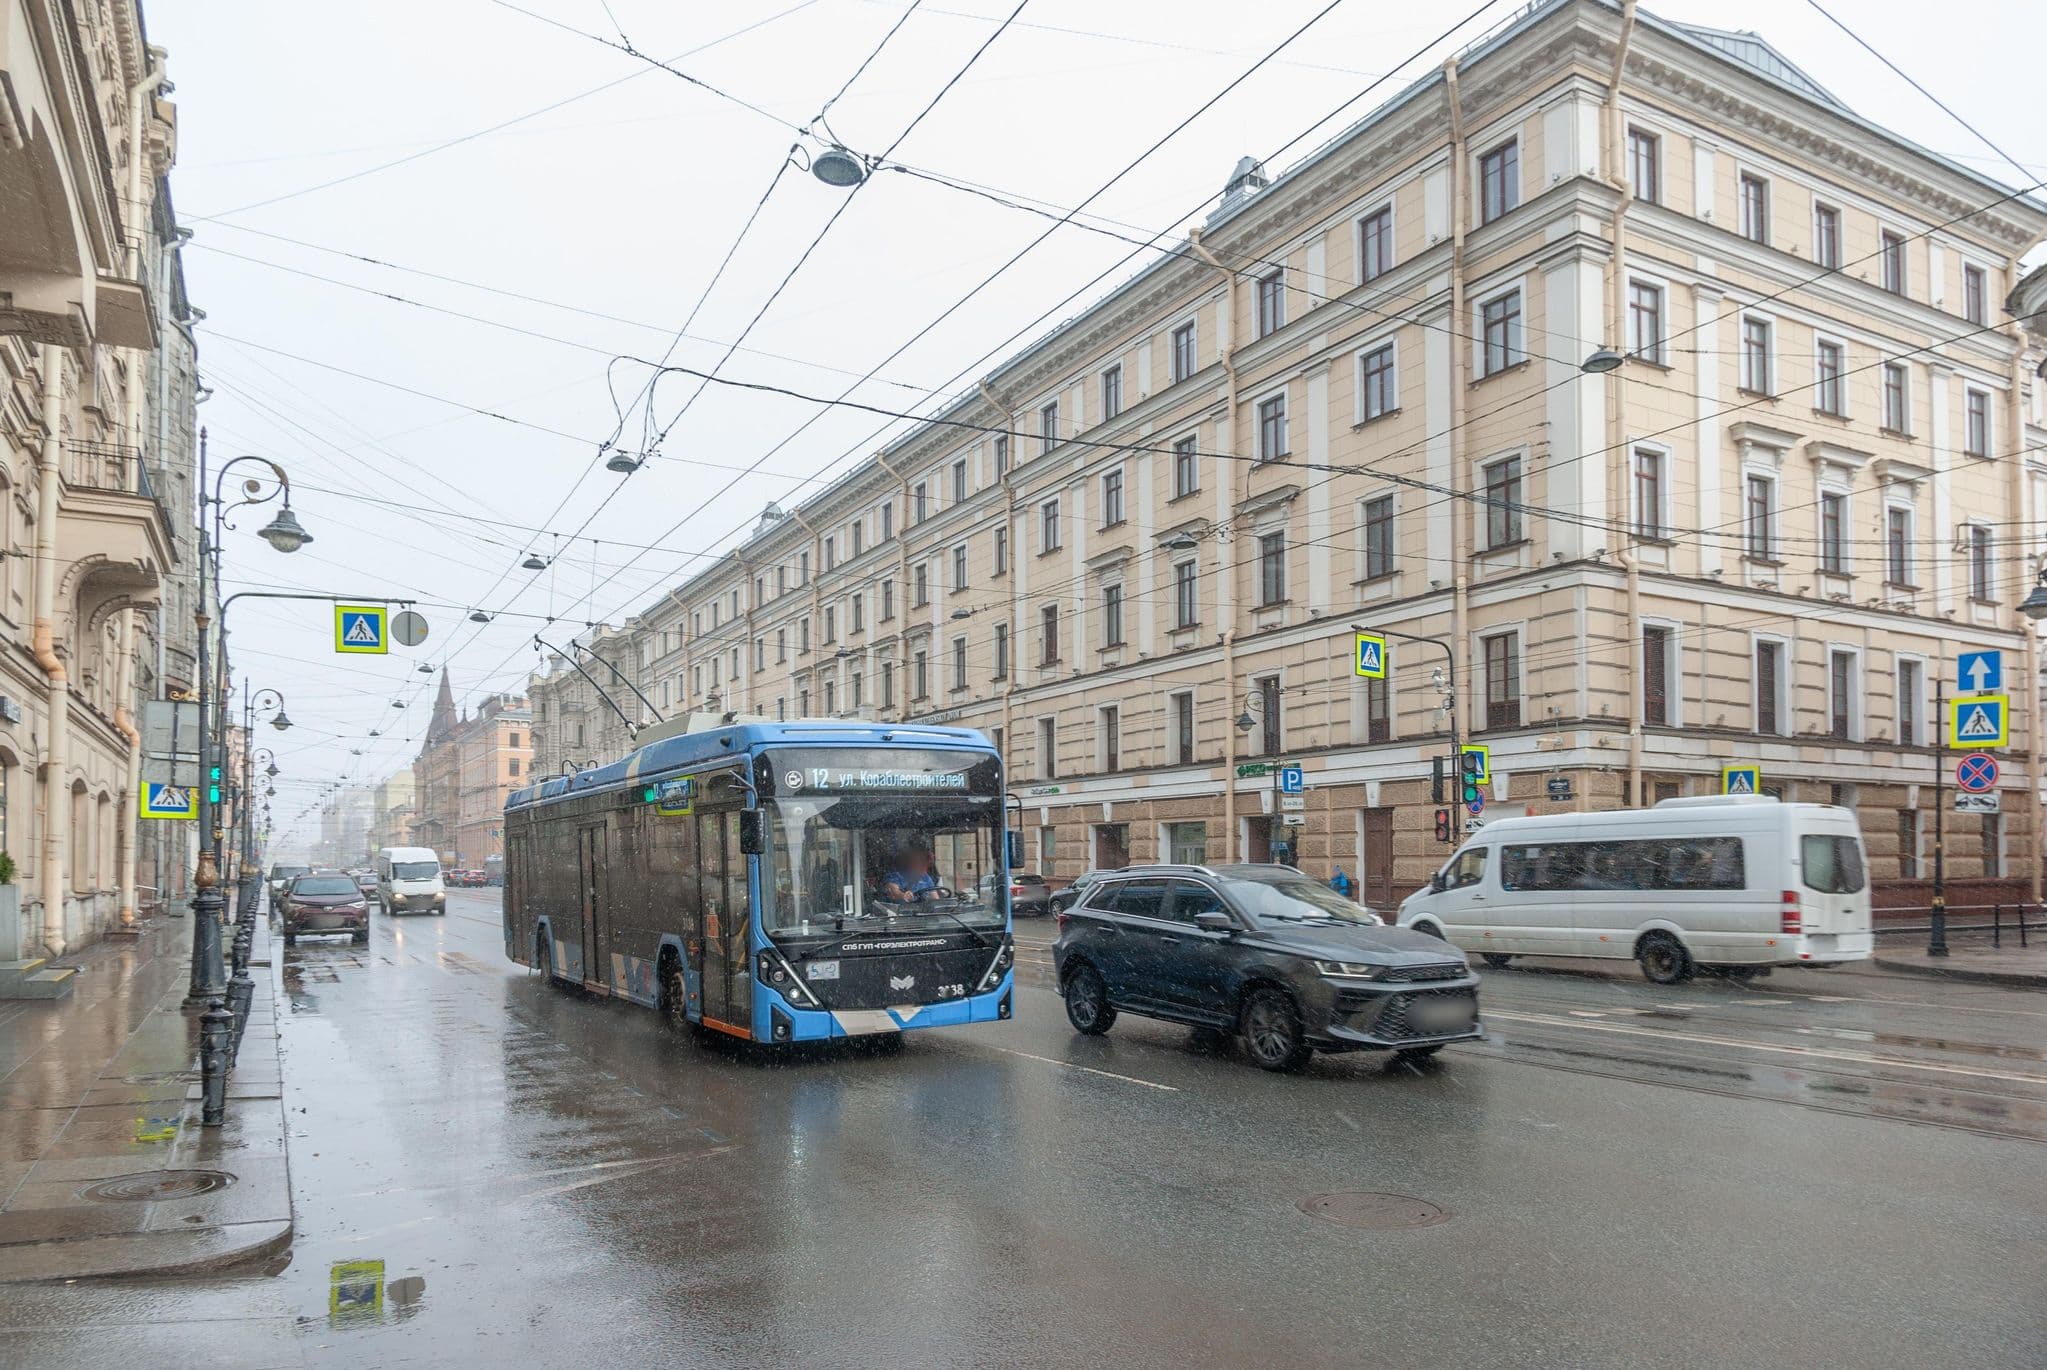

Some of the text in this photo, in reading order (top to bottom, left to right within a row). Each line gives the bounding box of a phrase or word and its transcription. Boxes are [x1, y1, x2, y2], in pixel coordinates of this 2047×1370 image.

[812, 768, 965, 788] 12 ул. Кораблестроителей
[1287, 770, 1299, 790] P
